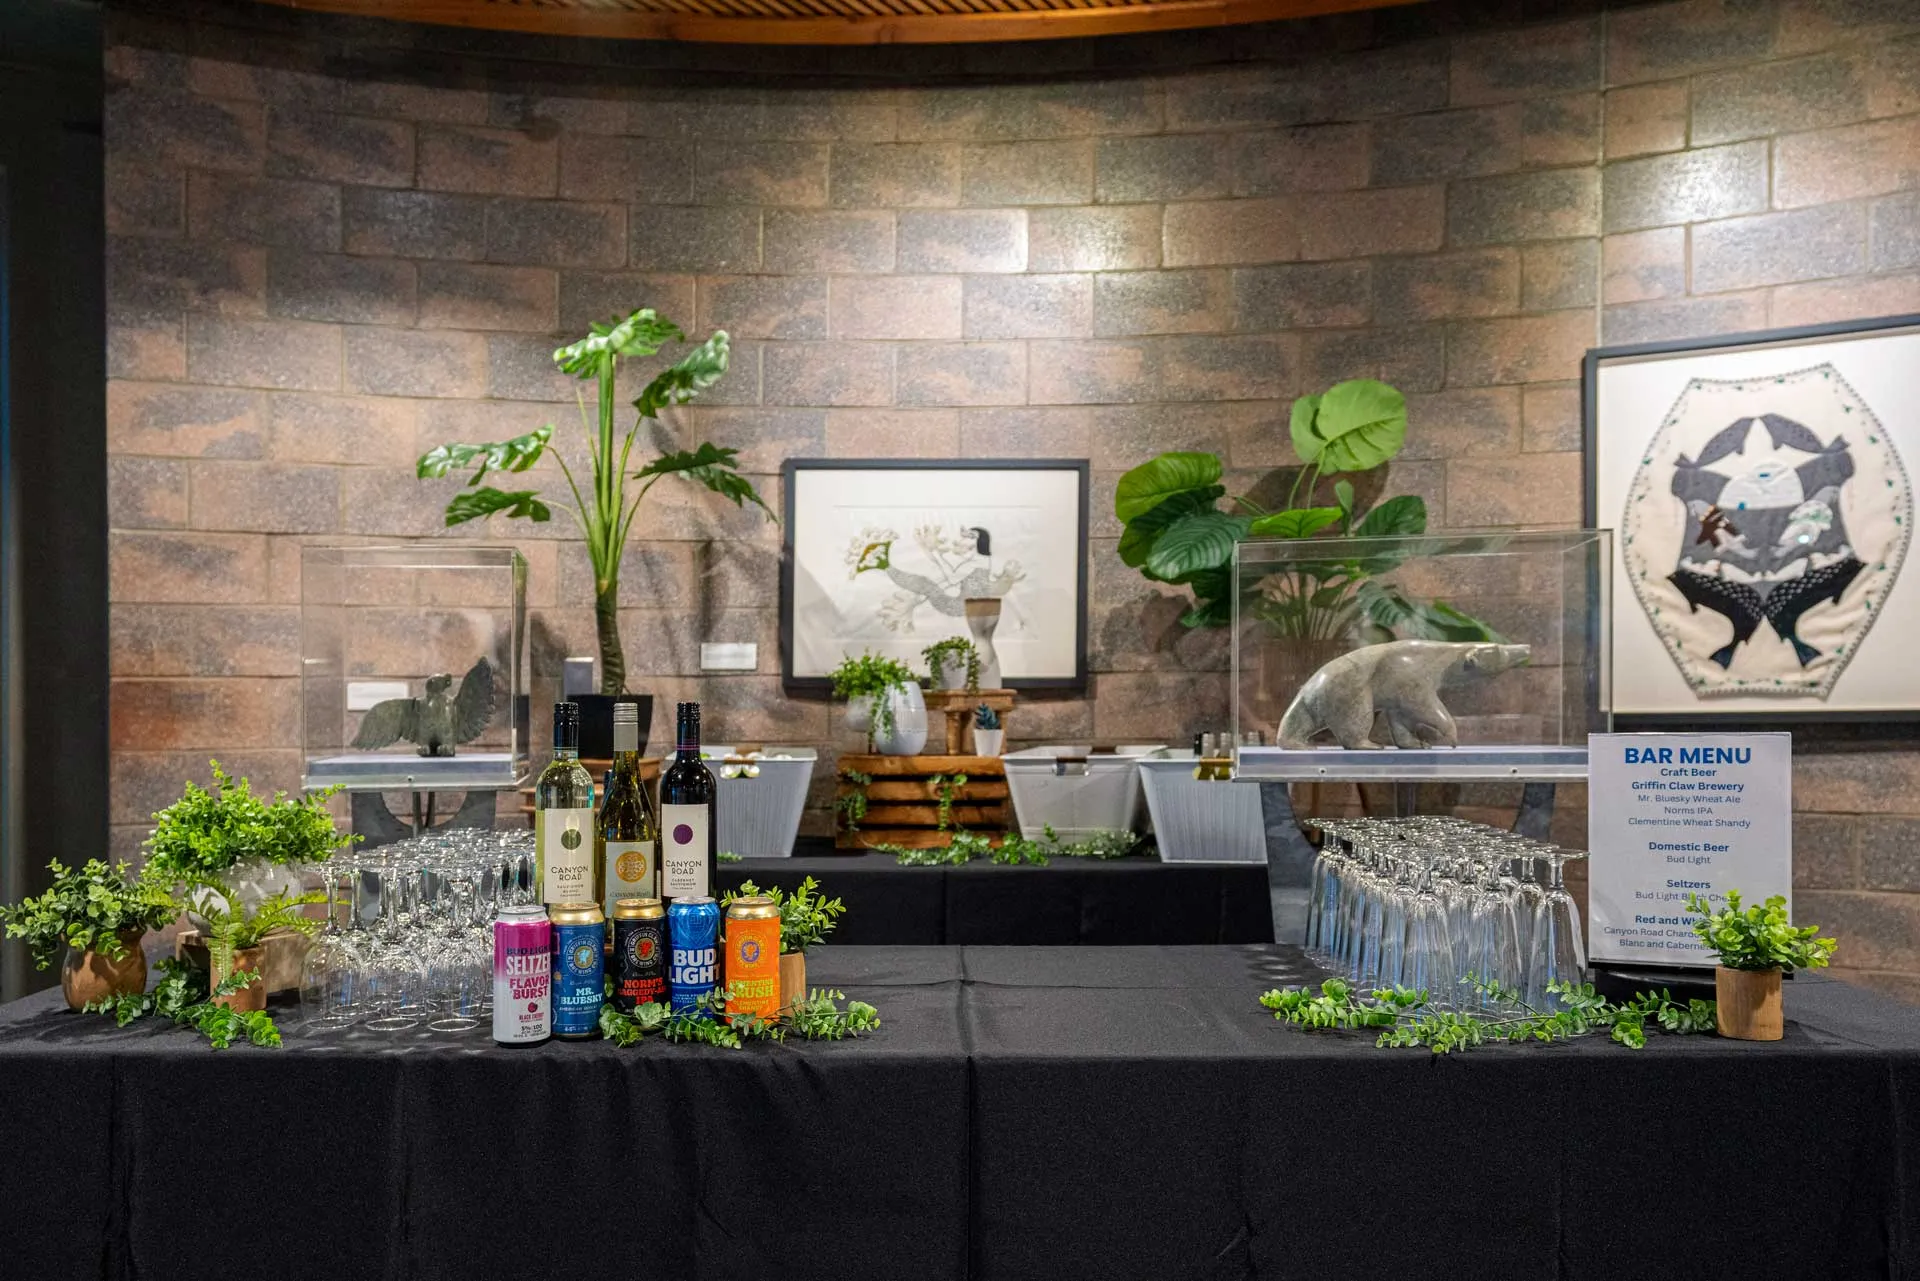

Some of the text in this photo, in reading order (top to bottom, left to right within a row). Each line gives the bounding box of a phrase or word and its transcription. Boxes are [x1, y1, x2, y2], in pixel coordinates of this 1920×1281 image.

[1625, 747, 1752, 764] BAR MENU
[1660, 768, 1717, 777] Craft Beer
[1631, 781, 1745, 793] Griffin Claw Brewery
[1638, 794, 1741, 804] Mr. Bluesky Wheat Ale
[1664, 806, 1713, 815] Norms IPA
[1628, 817, 1751, 829] Clementine Wheat Shandy
[1648, 842, 1730, 852] Domestic Beer
[665, 860, 702, 868] CANYON
[1666, 855, 1712, 866] Bud Light
[550, 865, 589, 874] CANYON
[671, 867, 694, 875] ROAD
[559, 873, 582, 881] ROAD
[1666, 879, 1711, 889] Seltzers
[1635, 891, 1654, 900] Bud
[1656, 892, 1679, 902] Light
[1635, 915, 1656, 924] Red
[1658, 916, 1679, 925] and
[1604, 926, 1638, 936] Canyon
[1640, 928, 1664, 936] Road
[1619, 939, 1709, 950] Blanc and Caberne
[673, 948, 717, 967] BUD
[668, 964, 720, 985] LIGHT
[509, 974, 550, 989] FLAVOR
[624, 977, 663, 989] NORM'S
[512, 985, 548, 1000] BURST
[575, 987, 595, 996] MR.
[733, 985, 774, 998] RUSH
[560, 993, 603, 1005] BLUESKY
[635, 996, 655, 1005] IPA
